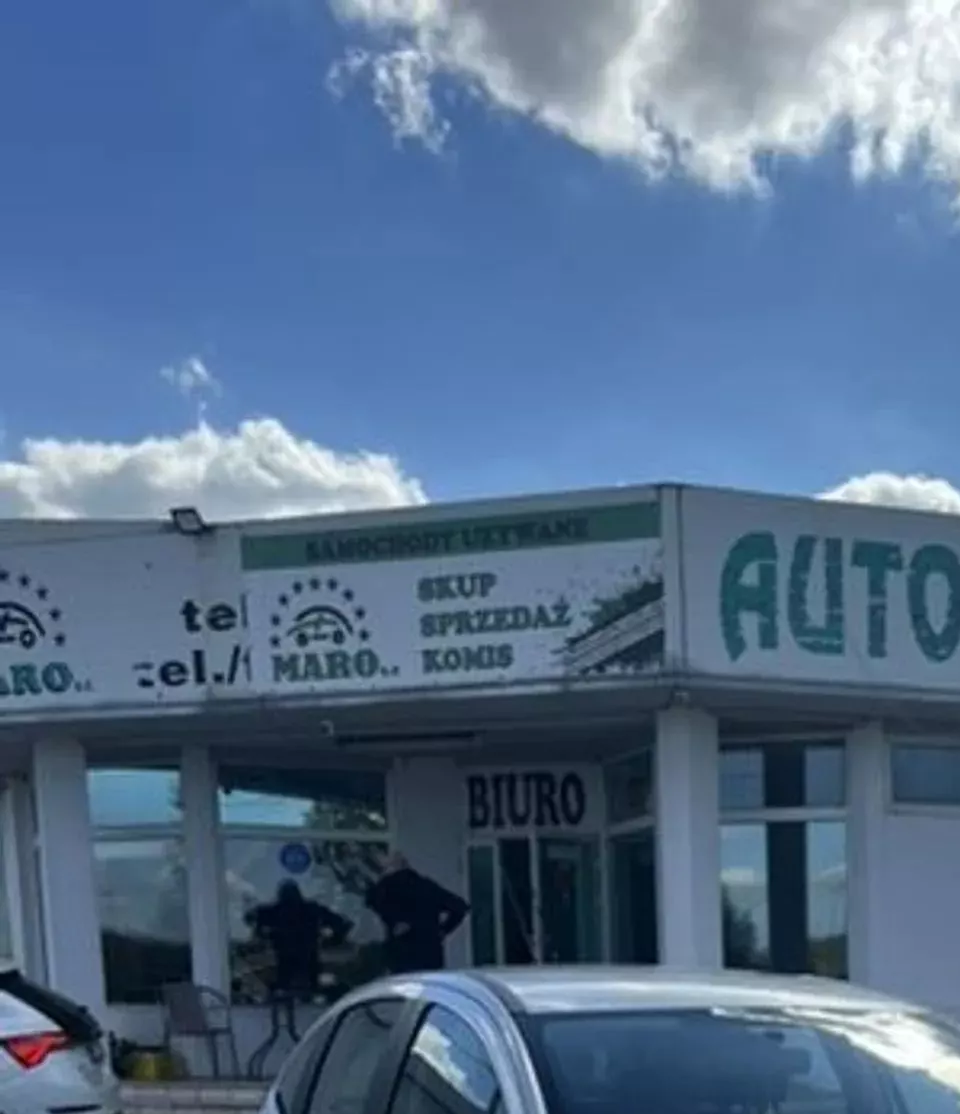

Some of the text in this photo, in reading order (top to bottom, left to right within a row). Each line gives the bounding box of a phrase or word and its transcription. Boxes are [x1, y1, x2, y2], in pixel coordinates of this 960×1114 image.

[417, 572, 497, 601] SKUP
[420, 597, 571, 637] SPRZEDAŻ
[271, 648, 380, 682] MARO
[422, 643, 514, 673] KOMIS
[466, 771, 587, 829] BIURO
